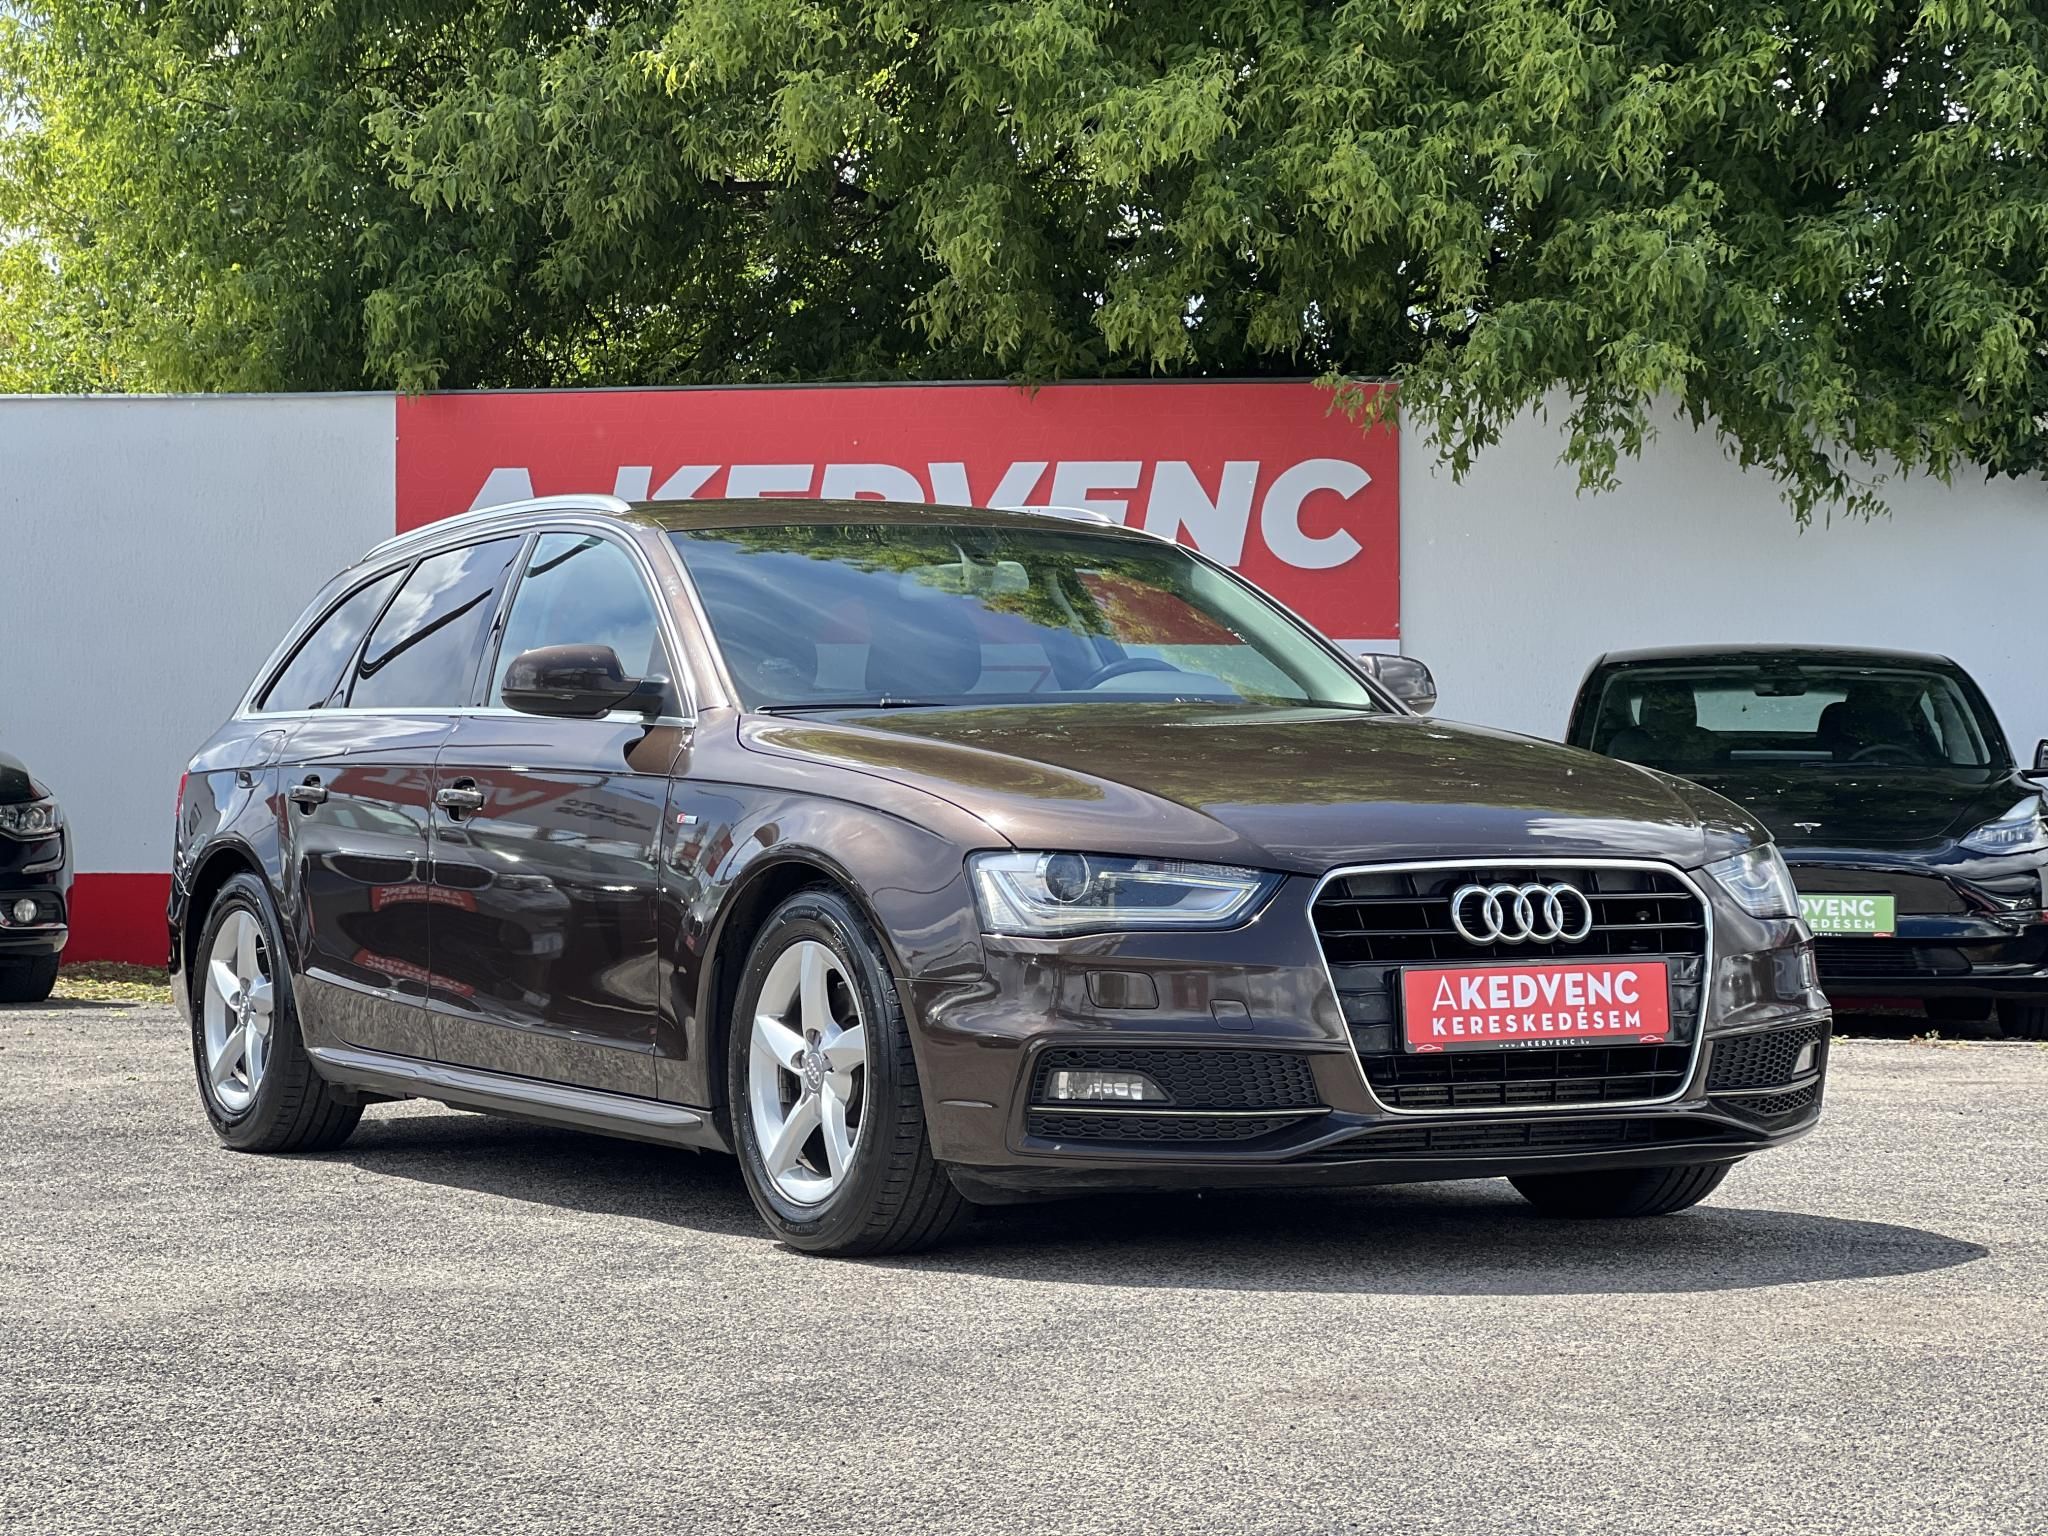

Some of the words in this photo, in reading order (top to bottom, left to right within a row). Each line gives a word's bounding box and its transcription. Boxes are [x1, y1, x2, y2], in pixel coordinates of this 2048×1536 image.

[1810, 917, 1876, 929] EDÉSEM
[1432, 971, 1639, 1011] AKEDVENC
[1432, 1007, 1641, 1035] KERESKEDÉSEM
